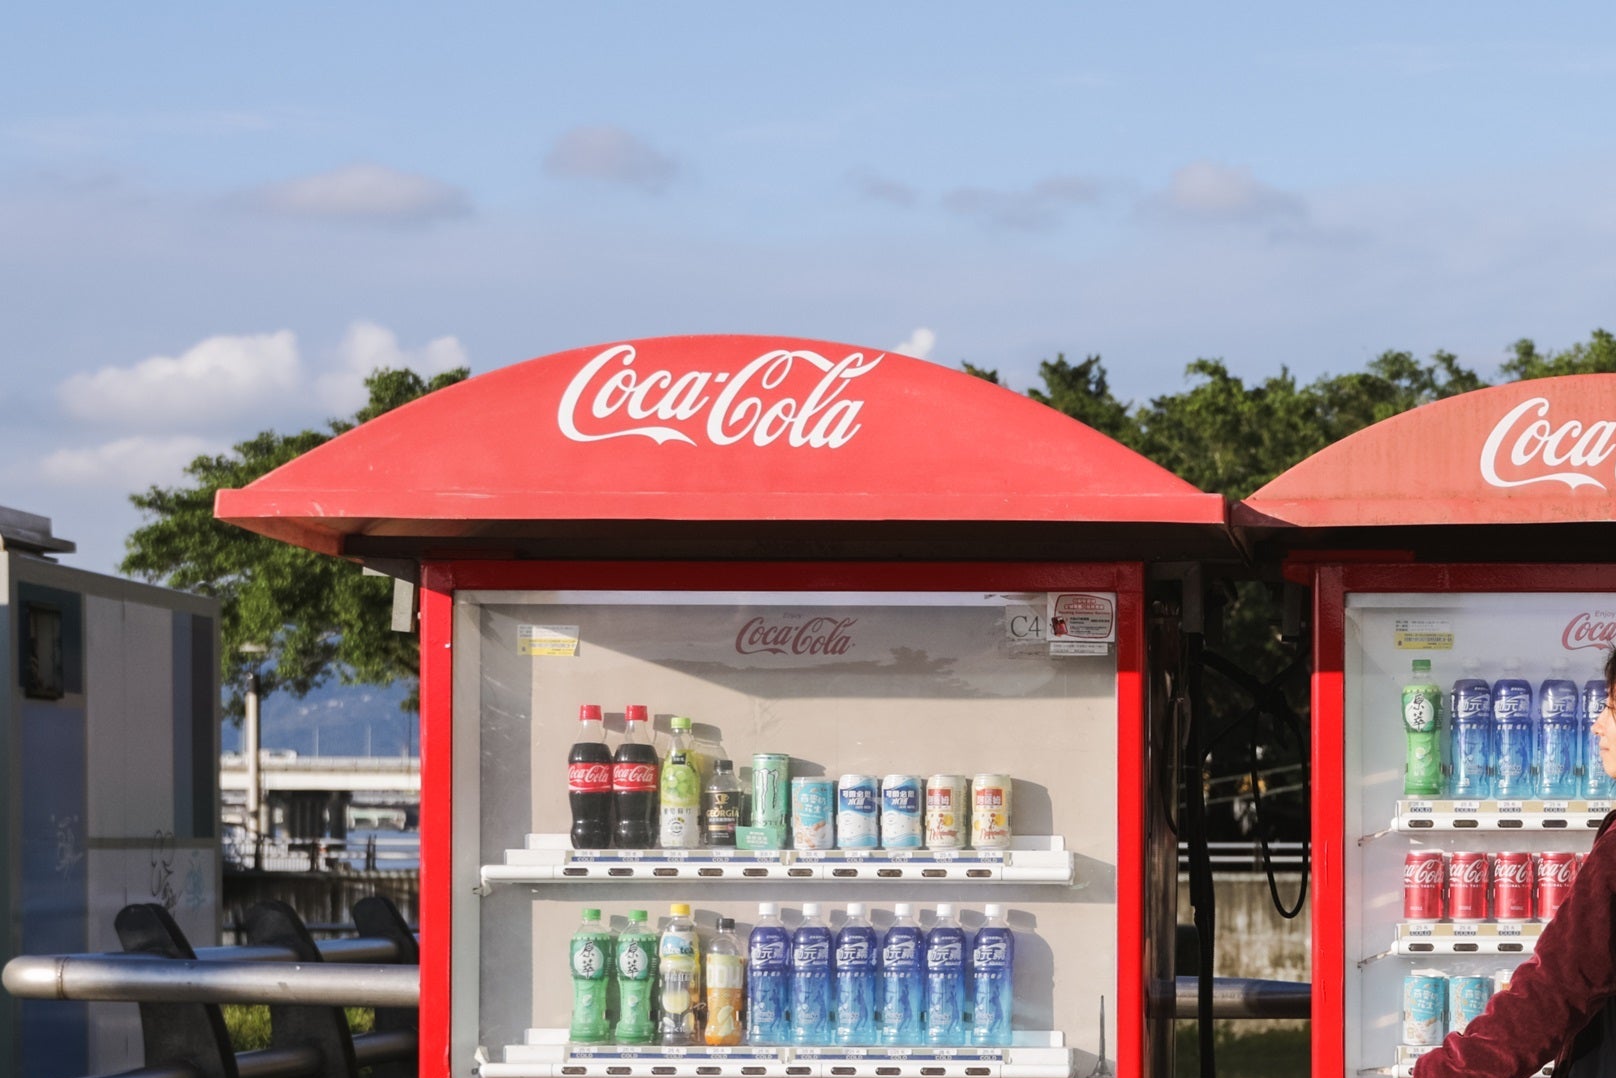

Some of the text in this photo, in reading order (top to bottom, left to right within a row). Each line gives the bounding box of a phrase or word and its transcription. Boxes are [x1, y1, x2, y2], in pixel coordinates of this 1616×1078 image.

[557, 345, 886, 448] Coca-Cola
[735, 616, 858, 655] Coca-Cola
[1011, 616, 1041, 637] C4
[706, 807, 740, 817] GEORGIA
